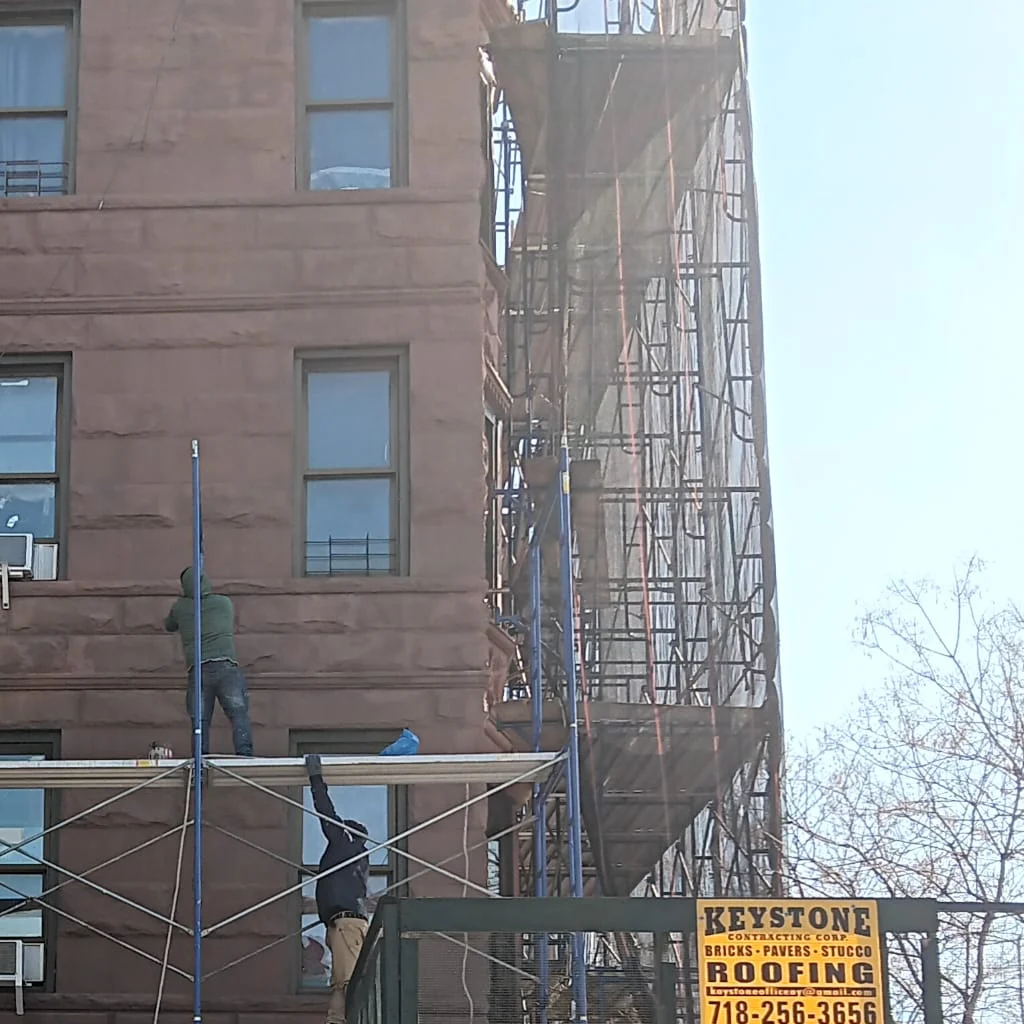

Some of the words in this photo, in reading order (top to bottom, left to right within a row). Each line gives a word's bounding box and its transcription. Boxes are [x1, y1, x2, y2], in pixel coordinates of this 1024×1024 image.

[704, 906, 872, 937] KEYSTONE
[728, 933, 811, 941] CONTRACTING
[704, 945, 753, 957] BRICKS
[763, 945, 811, 957] PAVERS
[821, 945, 872, 958] STUCCO
[707, 961, 874, 984] ROOFING
